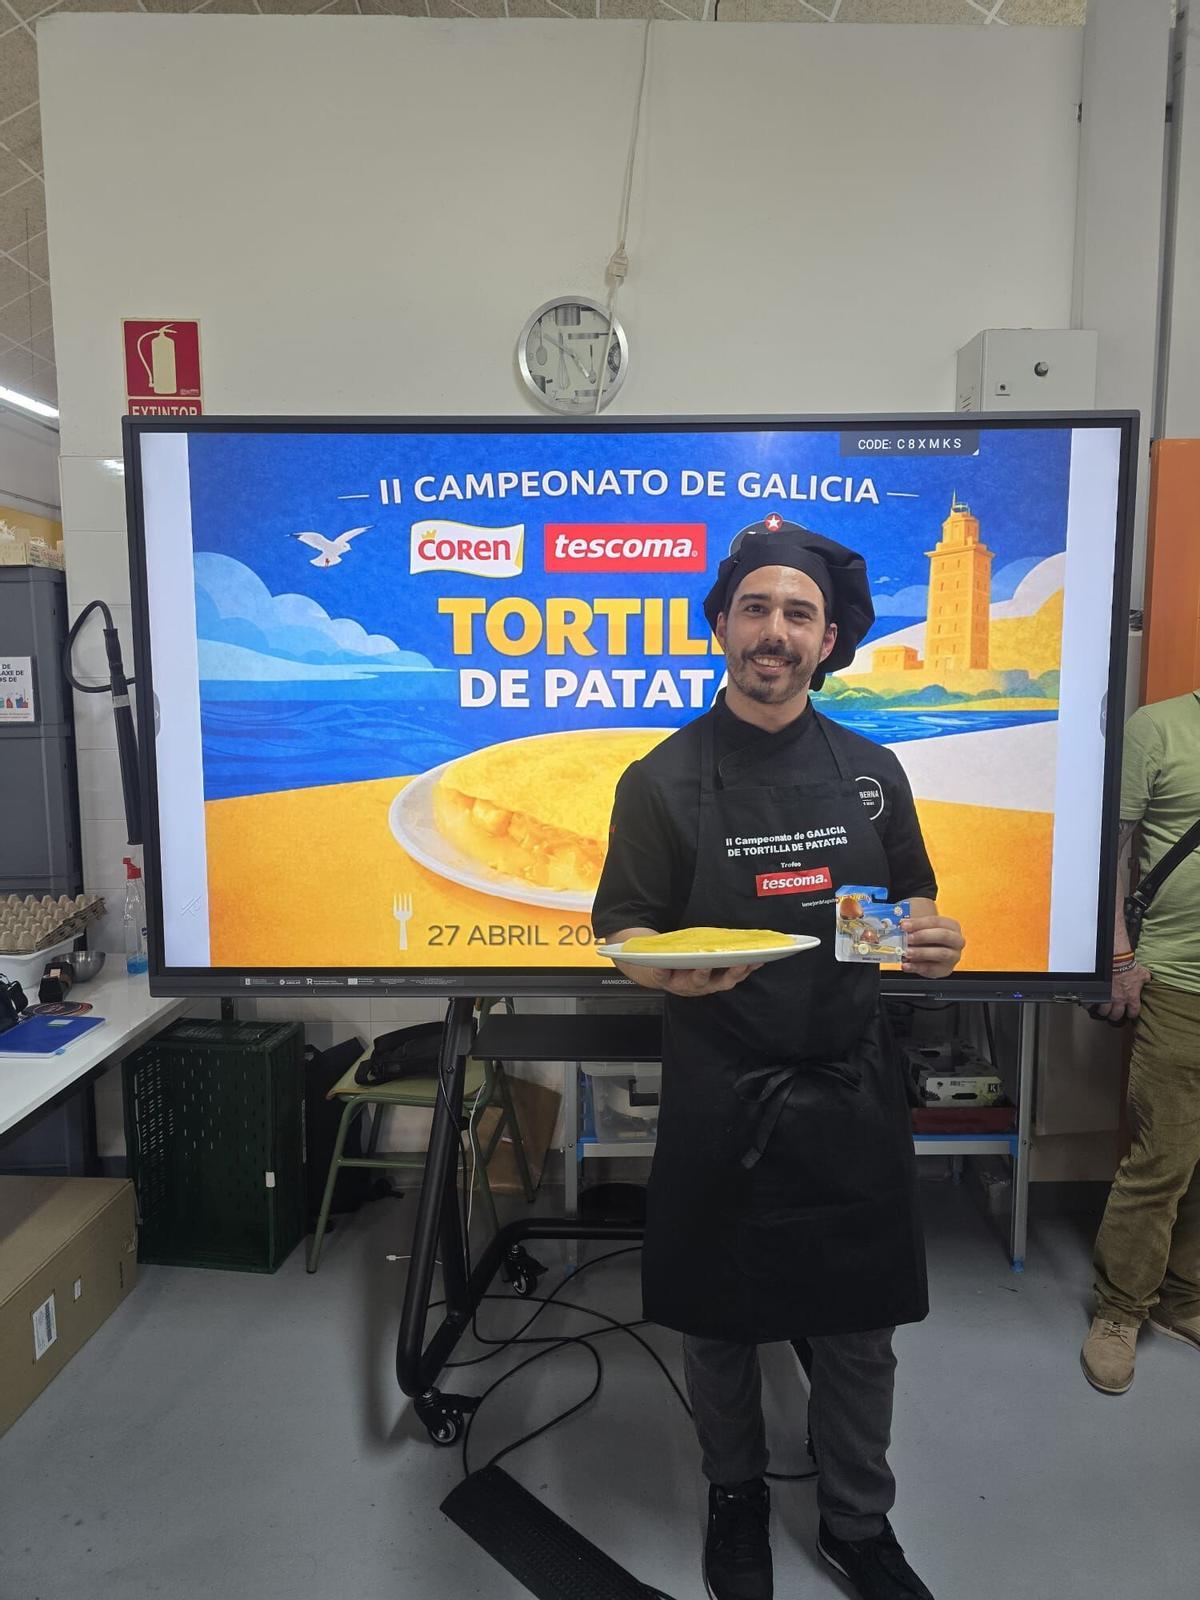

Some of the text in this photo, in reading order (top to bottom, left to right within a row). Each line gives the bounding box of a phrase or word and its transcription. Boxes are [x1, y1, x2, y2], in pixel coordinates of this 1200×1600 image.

[858, 439, 892, 450] CODE:
[379, 469, 880, 505] II CAMPEONATO DE GALICIA
[437, 597, 725, 656] TORTIL
[459, 669, 729, 708] DE PATAT
[727, 836, 848, 857] DE TORTILLA DE PATATAS
[734, 833, 792, 846] Campeonato
[793, 831, 805, 842] de
[806, 825, 847, 839] GALICIA
[428, 924, 460, 946] 27
[467, 924, 549, 946] ABRIL
